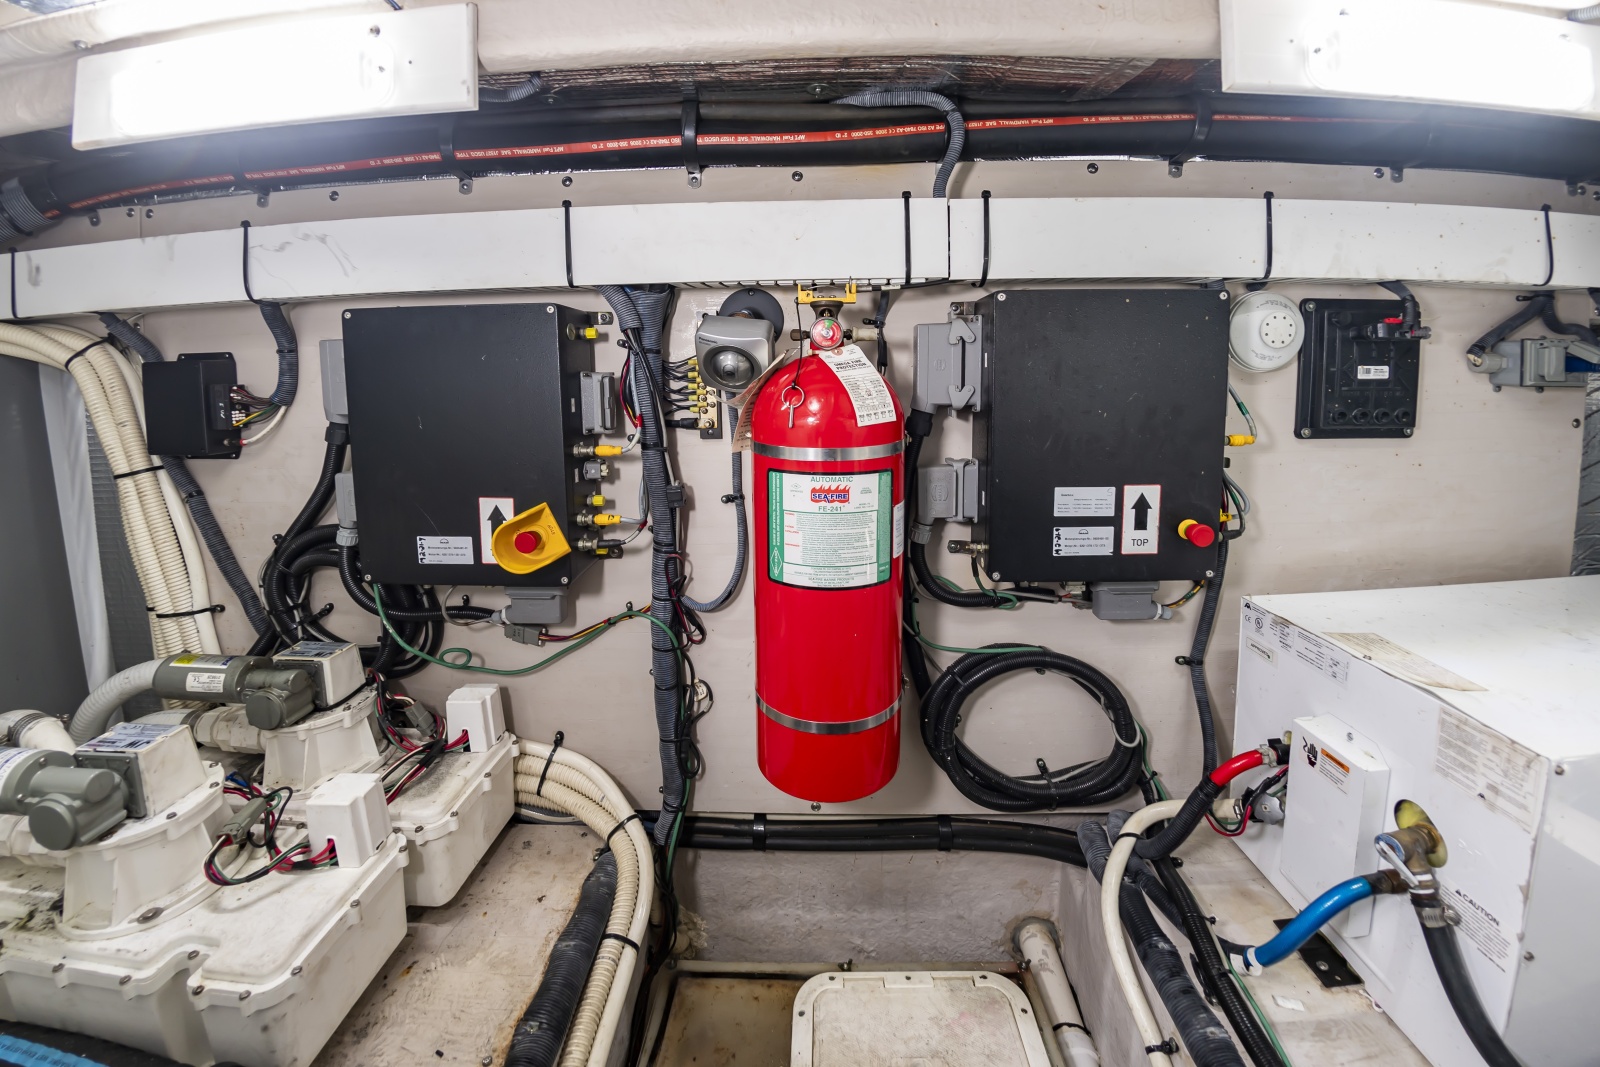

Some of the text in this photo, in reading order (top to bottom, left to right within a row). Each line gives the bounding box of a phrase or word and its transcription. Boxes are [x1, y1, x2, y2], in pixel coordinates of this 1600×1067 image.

[812, 493, 848, 502] SEA-FIRE
[1131, 538, 1149, 547] TOP
[1462, 894, 1499, 926] CAUTION
